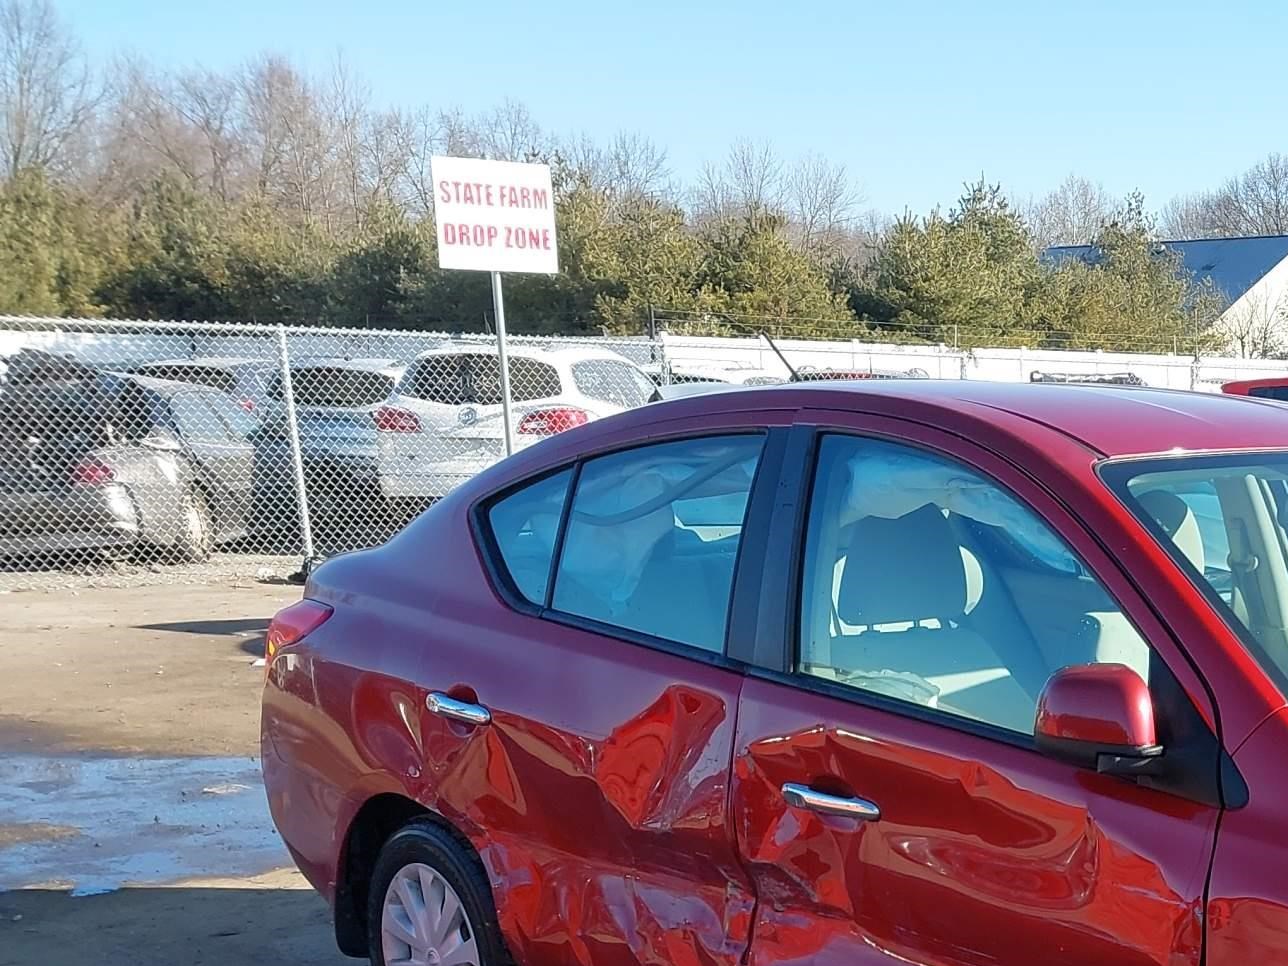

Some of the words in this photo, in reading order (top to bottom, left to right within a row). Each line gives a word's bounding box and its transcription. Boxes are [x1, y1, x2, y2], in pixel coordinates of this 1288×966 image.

[440, 180, 494, 206] STATE
[500, 185, 548, 210] FARM
[444, 223, 498, 247] DROP
[504, 226, 551, 250] ZONE
